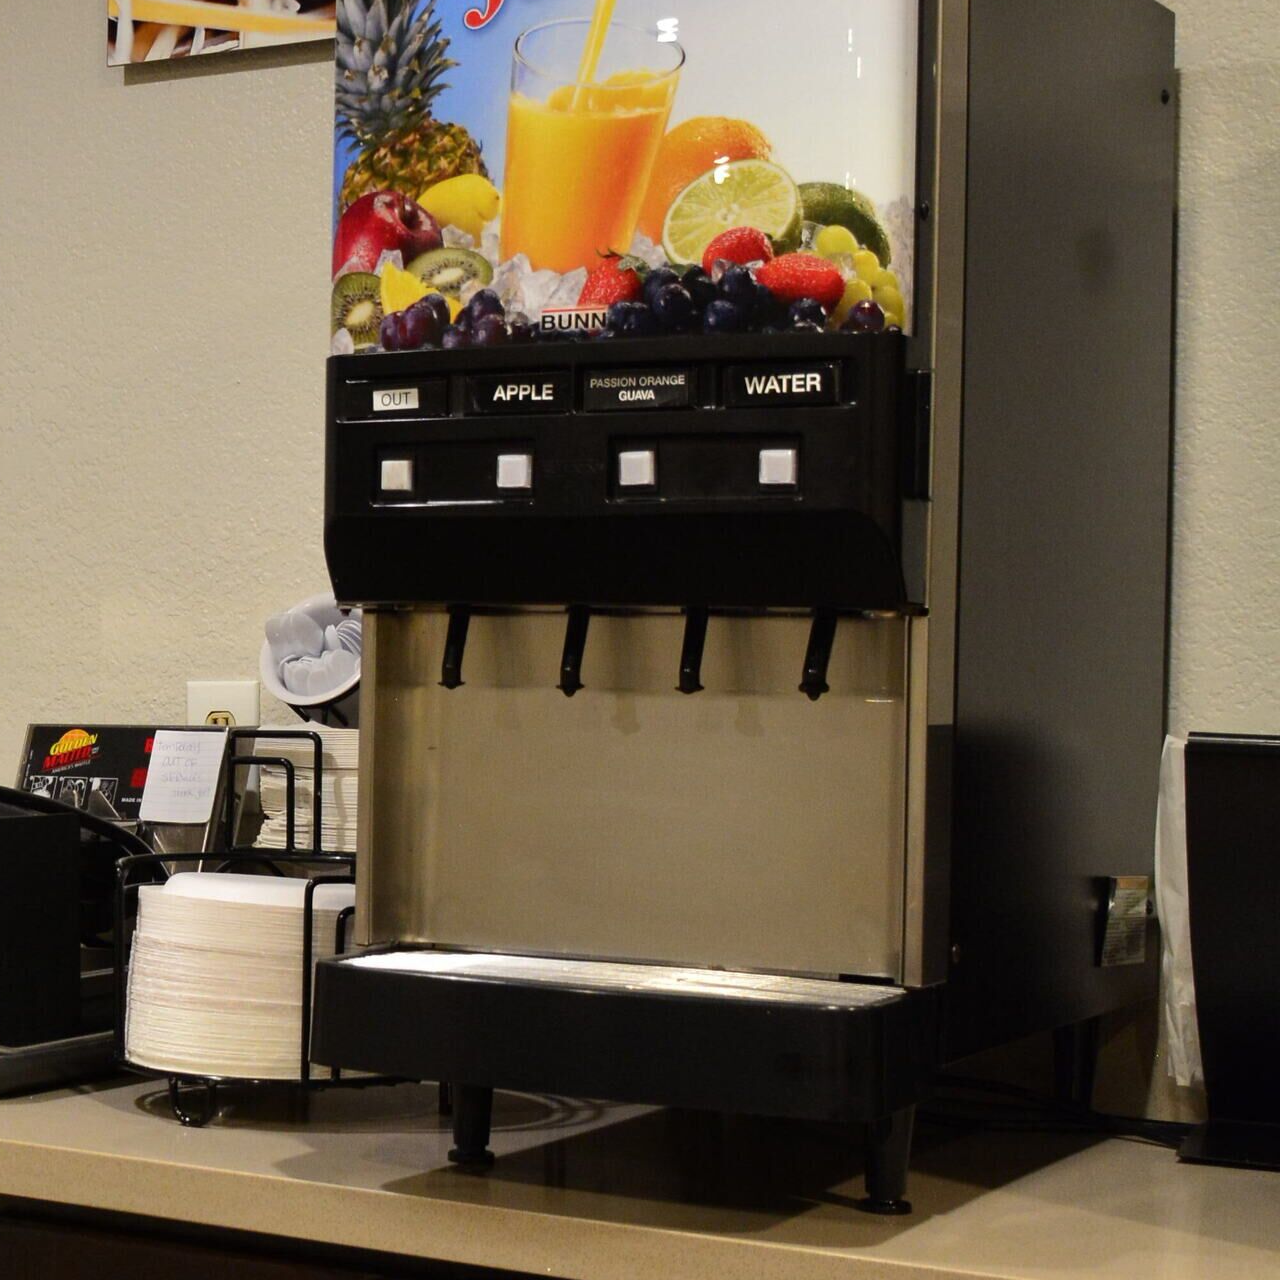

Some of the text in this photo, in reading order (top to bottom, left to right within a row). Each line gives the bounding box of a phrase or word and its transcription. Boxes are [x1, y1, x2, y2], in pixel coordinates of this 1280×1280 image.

[541, 312, 607, 332] BUNN
[589, 374, 686, 389] PASSION ORANGE
[744, 373, 822, 395] WATER
[380, 391, 412, 407] OUT
[492, 384, 554, 402] APPLE
[618, 389, 656, 402] GUAVA
[50, 733, 98, 756] GOLDEN
